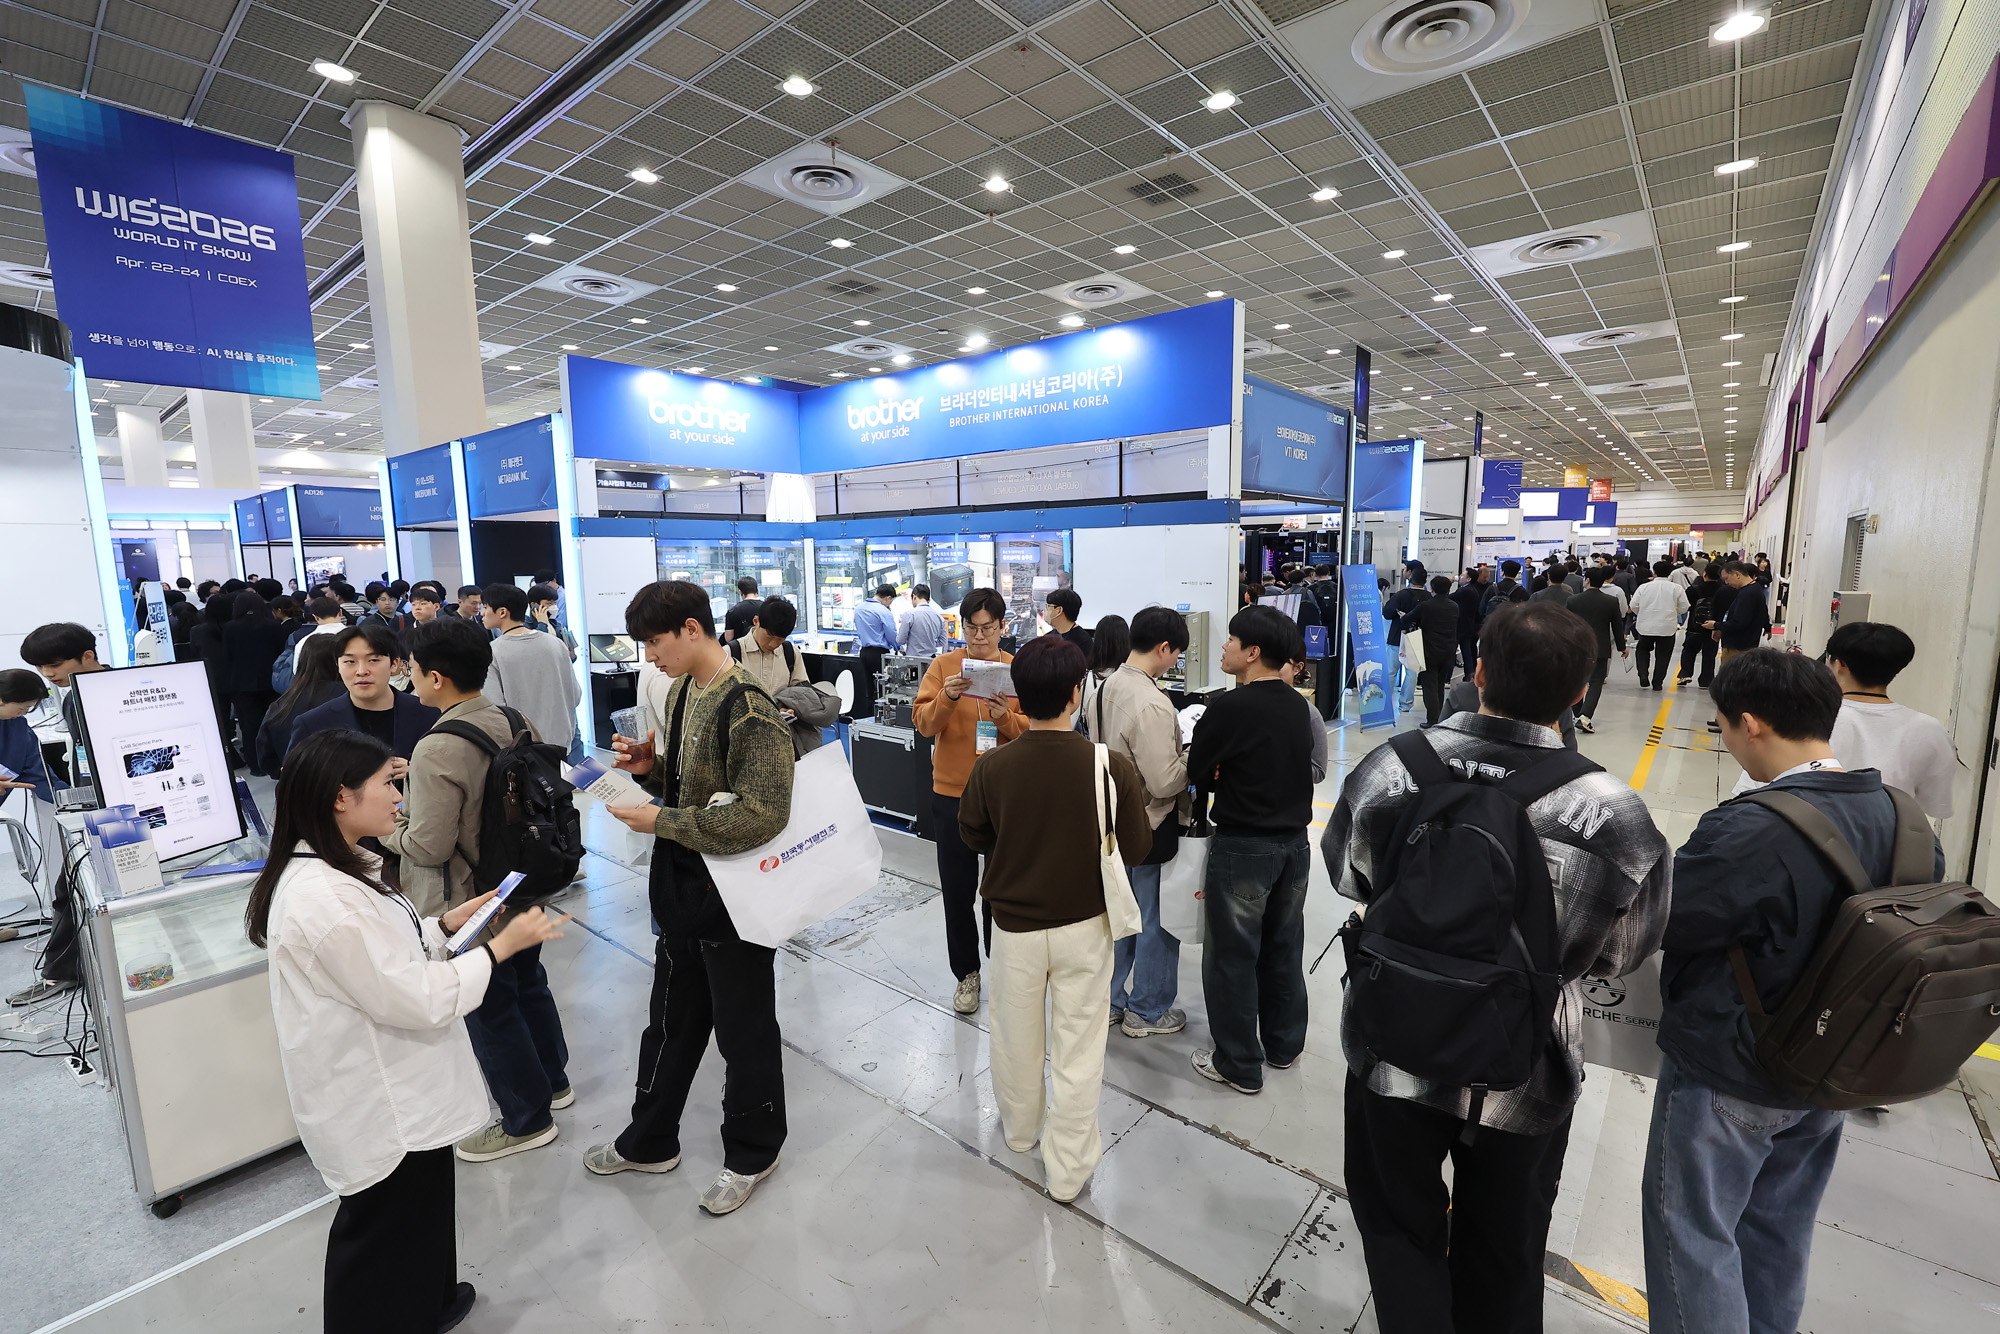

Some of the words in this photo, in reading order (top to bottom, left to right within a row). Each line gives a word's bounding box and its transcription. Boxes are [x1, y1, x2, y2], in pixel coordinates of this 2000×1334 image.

[75, 186, 277, 251] WIS2026
[113, 227, 180, 248] WORLD
[201, 244, 252, 262] SHOW
[115, 256, 148, 269] Apr.
[151, 261, 201, 278] 22-24
[217, 273, 258, 288] COEX
[88, 332, 124, 345] 생각을
[126, 337, 150, 349] 넘어
[206, 348, 222, 359] AI,
[223, 350, 255, 362] 현실을
[256, 353, 298, 367] 움직이다.
[939, 364, 1123, 413] 브라더인터내셔널코리아(주)
[648, 395, 751, 433] brother
[847, 396, 924, 431] brother
[949, 411, 991, 428] BROTHER
[992, 402, 1070, 420] INTERNATIONAL
[1073, 394, 1110, 411] KOREA
[669, 428, 682, 441] at
[684, 430, 711, 444] your
[712, 430, 735, 446] side
[860, 430, 870, 442] at
[871, 427, 892, 444] your
[892, 424, 910, 438] side
[1293, 448, 1309, 461] KOREA
[304, 488, 324, 497] AD126
[626, 481, 648, 489] 페스티벌
[1424, 527, 1457, 535] DEFOG
[122, 698, 143, 706] 파트너
[158, 692, 178, 701] 플랫폼
[128, 688, 149, 698] 산학연
[149, 686, 167, 695] R&D
[132, 740, 151, 748] Science
[1582, 1006, 1622, 1024] RCHE
[1624, 1016, 1661, 1030] SERVE
